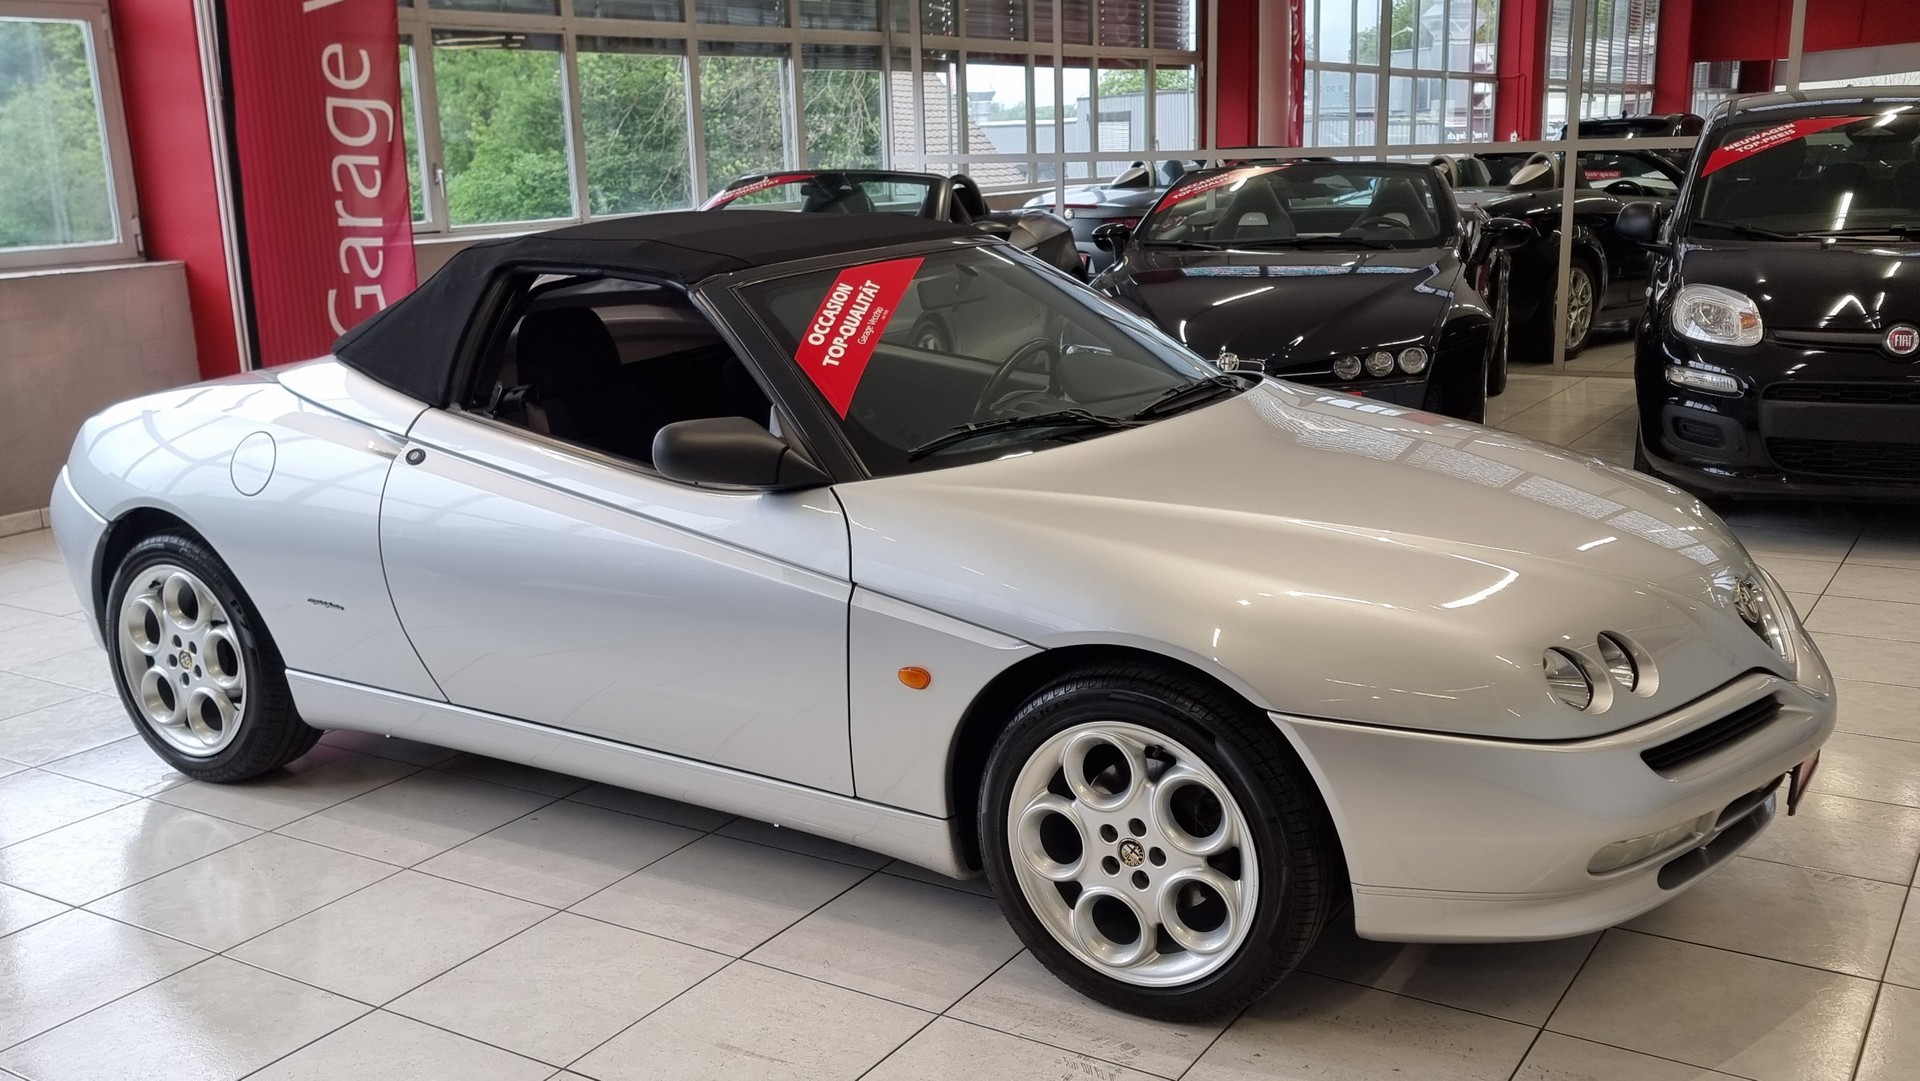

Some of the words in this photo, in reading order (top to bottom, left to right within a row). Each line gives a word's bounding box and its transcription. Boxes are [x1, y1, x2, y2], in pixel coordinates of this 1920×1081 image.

[1723, 123, 1796, 151] NEUWAGEN
[1735, 129, 1796, 152] TOP-PREIS
[321, 43, 394, 337] Garage
[1179, 173, 1228, 192] OCCASION
[808, 282, 854, 346] OCCASION
[822, 279, 881, 367] TOP-QUALITÄT
[857, 324, 875, 345] Garage
[1894, 334, 1914, 347] FIAT
